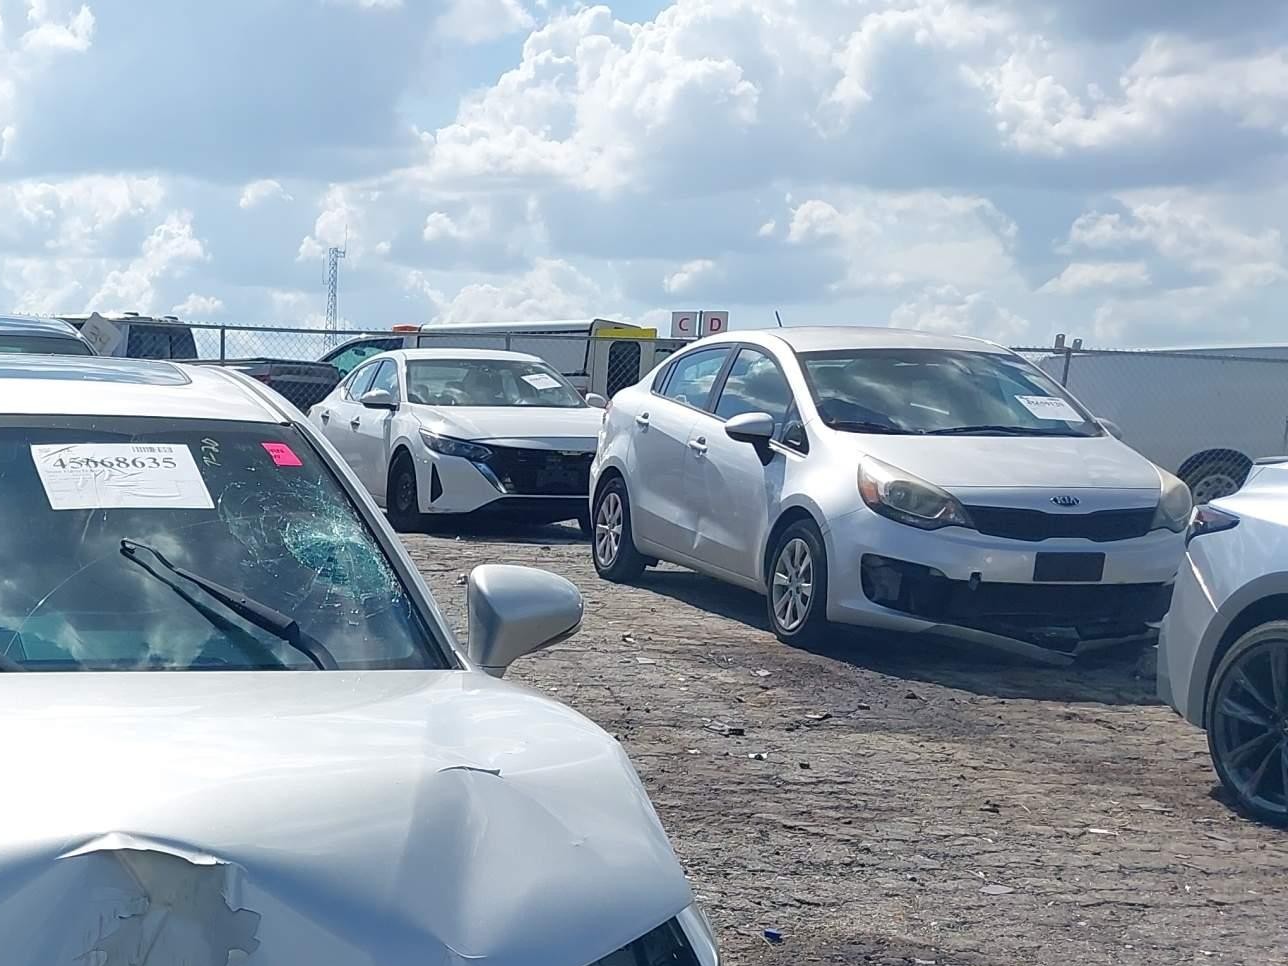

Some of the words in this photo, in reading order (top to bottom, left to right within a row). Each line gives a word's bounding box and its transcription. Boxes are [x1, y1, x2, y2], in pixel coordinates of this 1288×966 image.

[678, 318, 690, 331] C
[710, 318, 721, 331] D
[52, 457, 177, 470] 45668635
[1051, 495, 1080, 505] KIA
